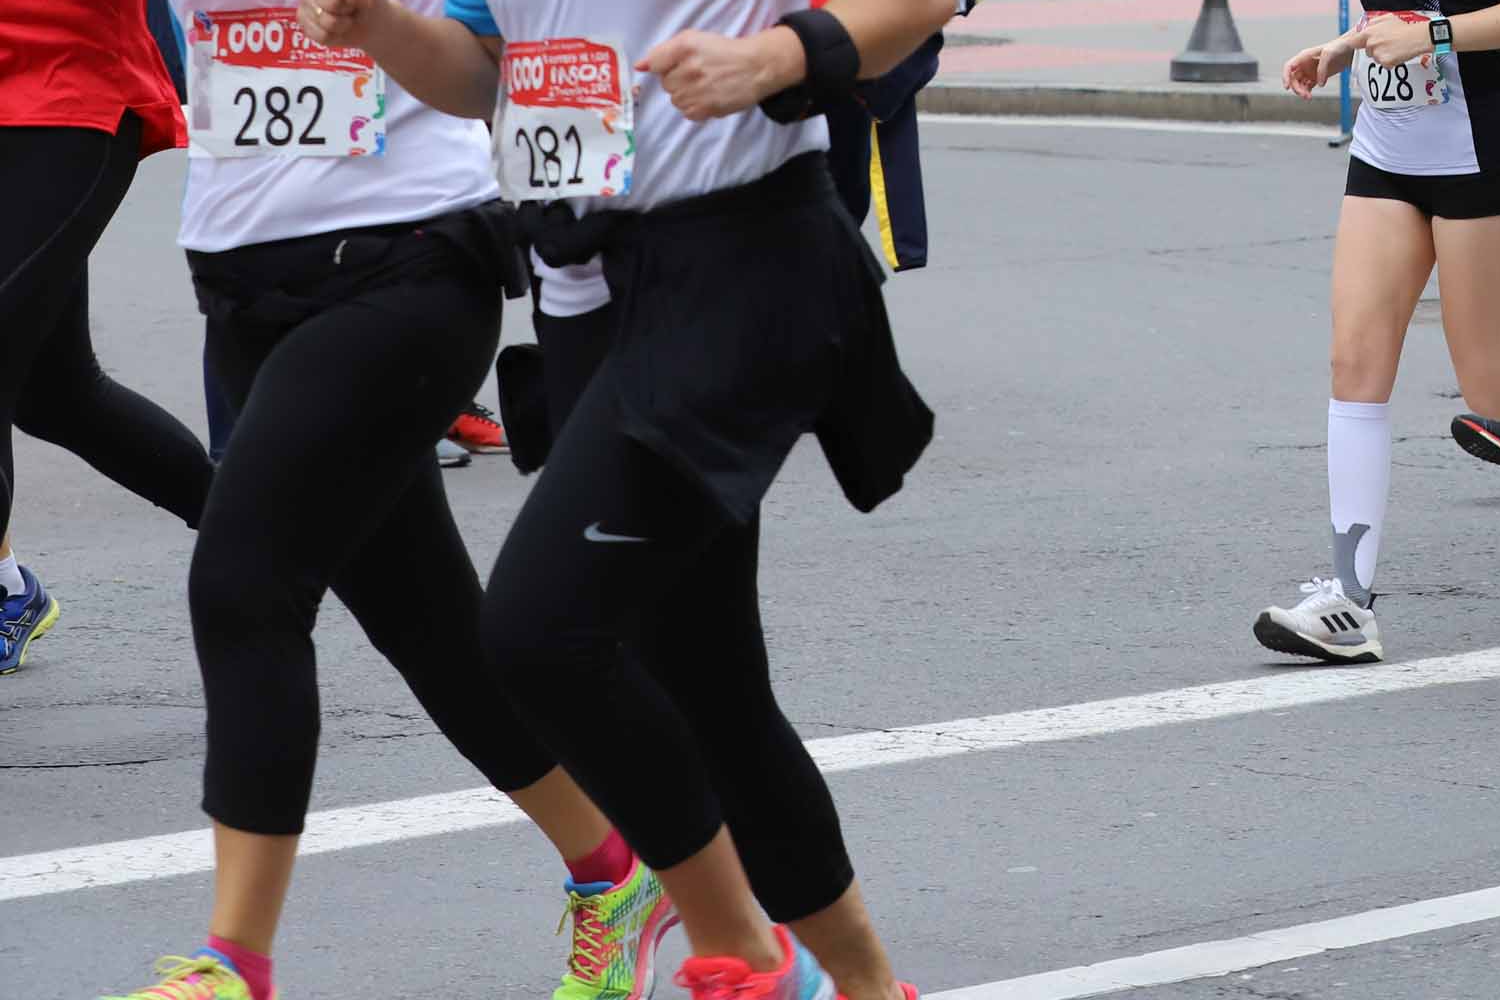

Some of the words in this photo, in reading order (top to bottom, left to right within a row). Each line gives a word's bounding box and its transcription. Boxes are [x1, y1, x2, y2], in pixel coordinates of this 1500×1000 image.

[1367, 62, 1413, 102] 628
[233, 85, 326, 146] 282
[515, 125, 584, 188] 281
